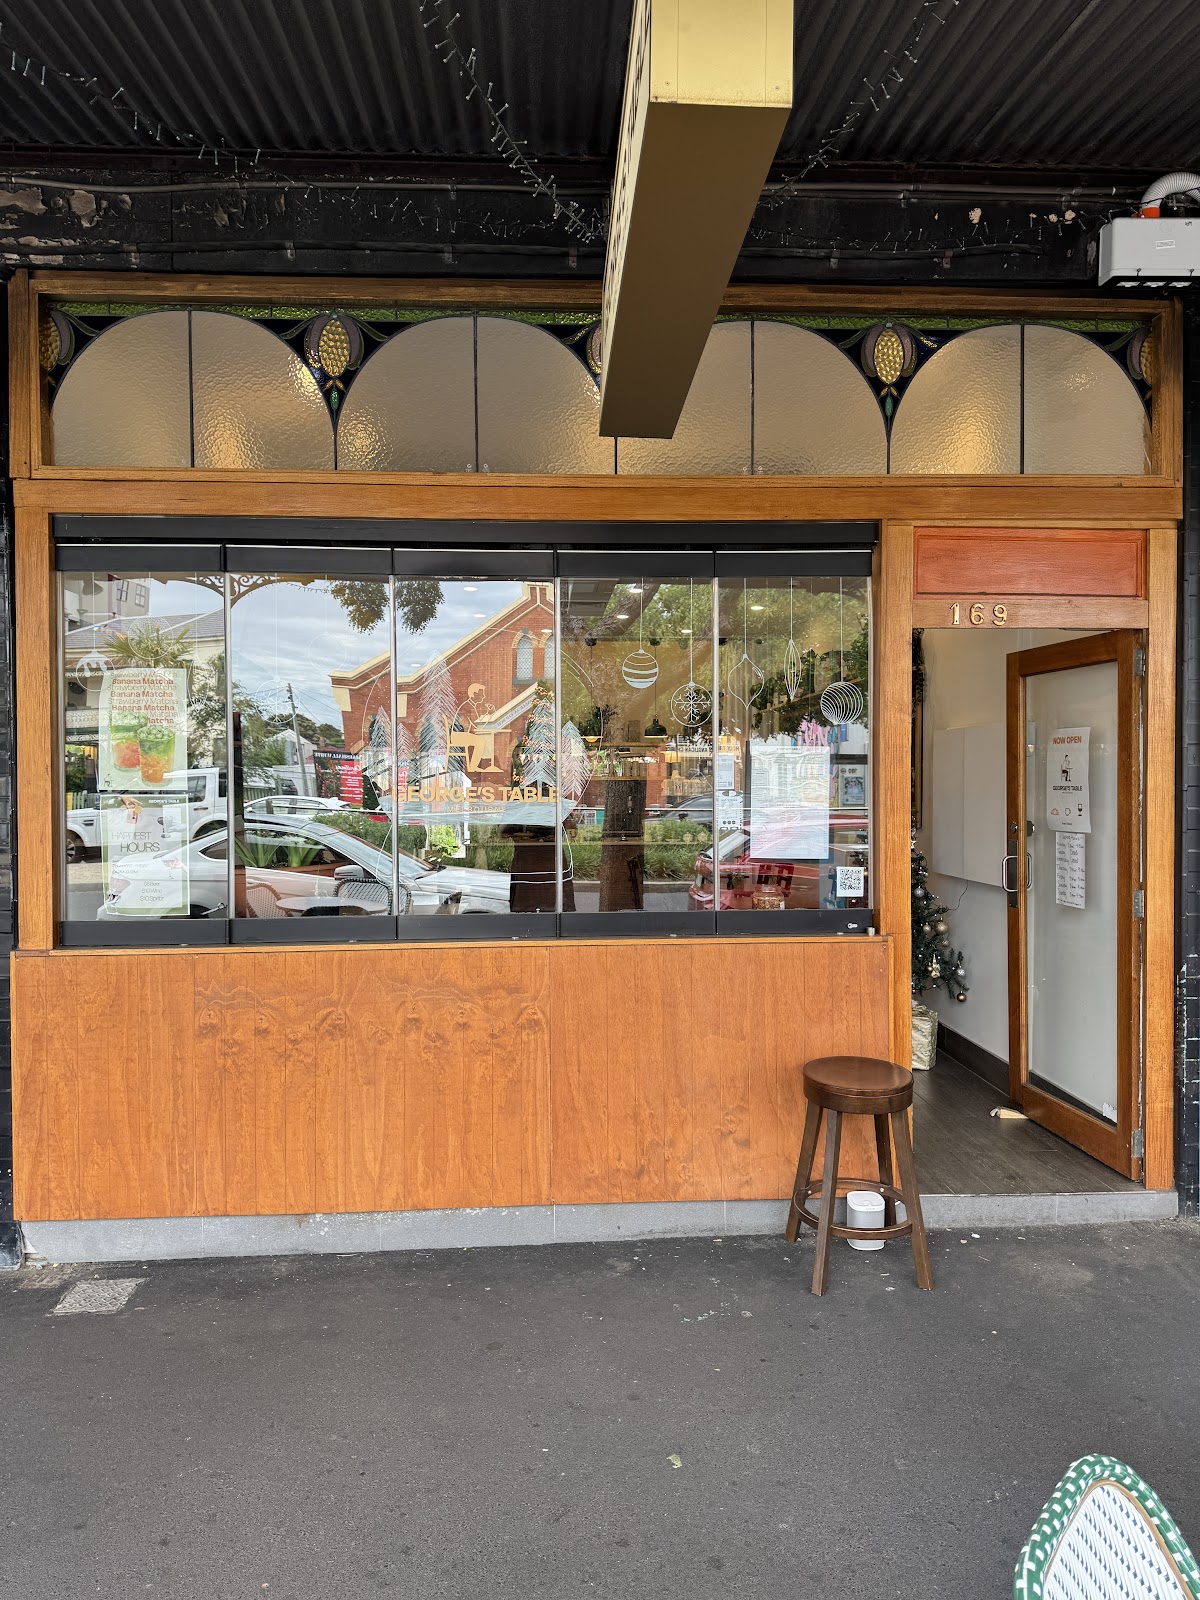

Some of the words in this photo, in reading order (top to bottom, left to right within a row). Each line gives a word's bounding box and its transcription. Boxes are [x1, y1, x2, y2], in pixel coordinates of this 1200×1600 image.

[949, 603, 1007, 626] 169
[107, 697, 149, 705] Strawberry
[150, 697, 178, 705] Matcha
[1066, 736, 1082, 744] OPEN
[392, 786, 496, 803] GEORGE'S
[501, 786, 560, 803] TABLE
[120, 841, 160, 852] HOURS
